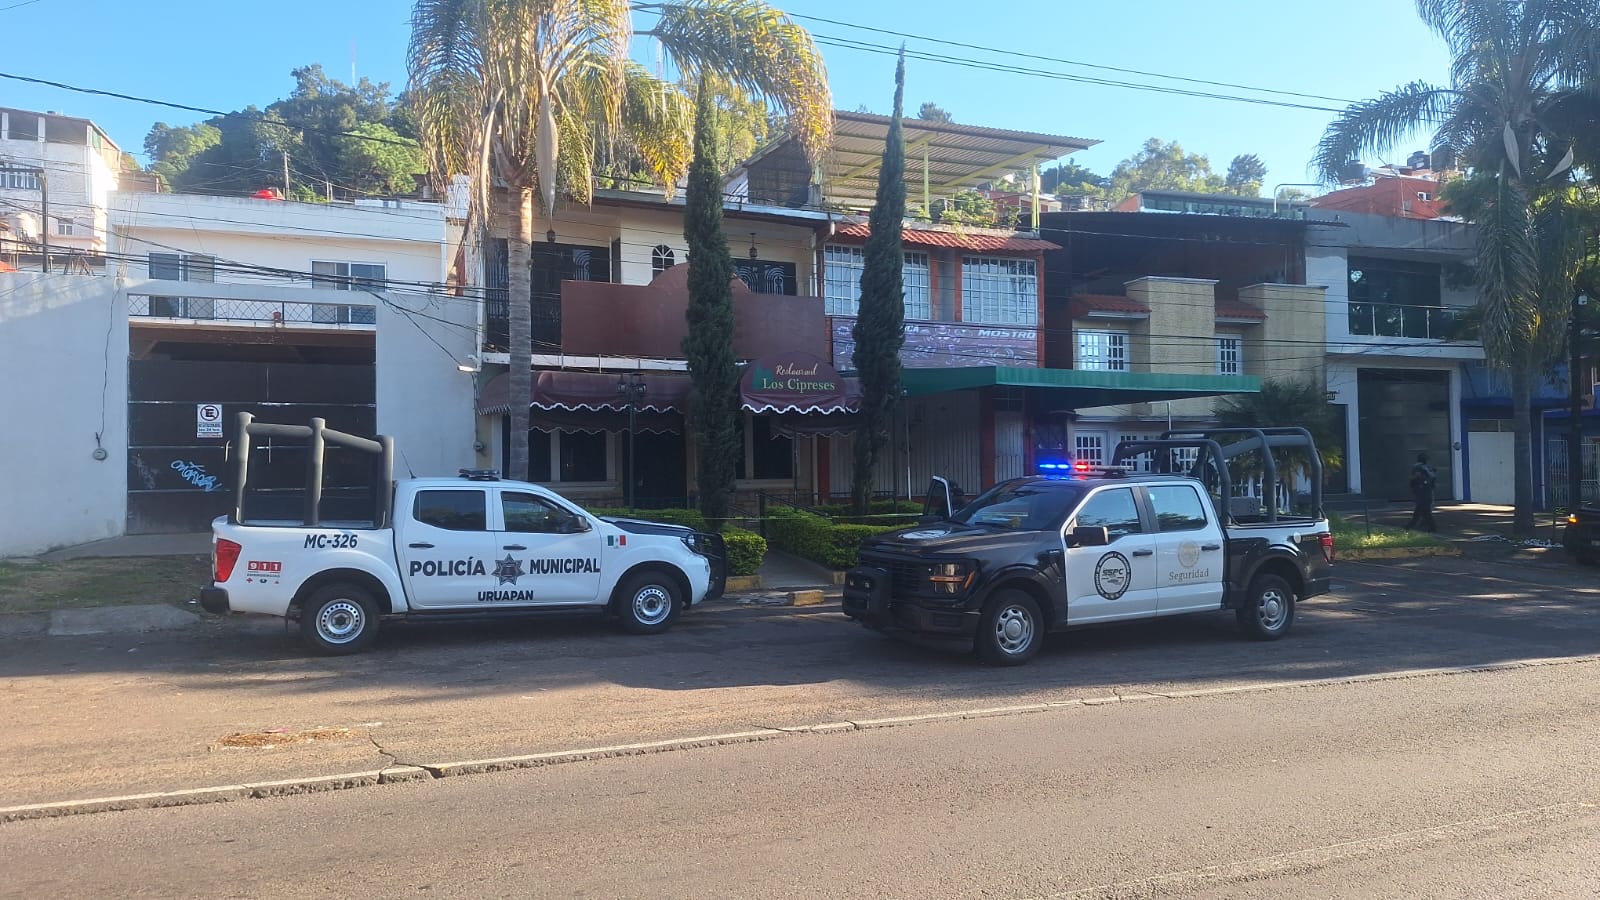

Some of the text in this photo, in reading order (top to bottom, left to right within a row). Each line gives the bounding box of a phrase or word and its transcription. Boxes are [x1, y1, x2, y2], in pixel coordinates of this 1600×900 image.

[763, 378, 835, 393] Los Cipreses
[303, 534, 358, 549] MC-326
[249, 562, 280, 571] 911
[409, 556, 601, 577] POLICÍA MUNICIPAL
[1102, 568, 1124, 576] SSPC
[1168, 568, 1209, 582] Seguridad
[477, 589, 534, 602] URUAPAN
